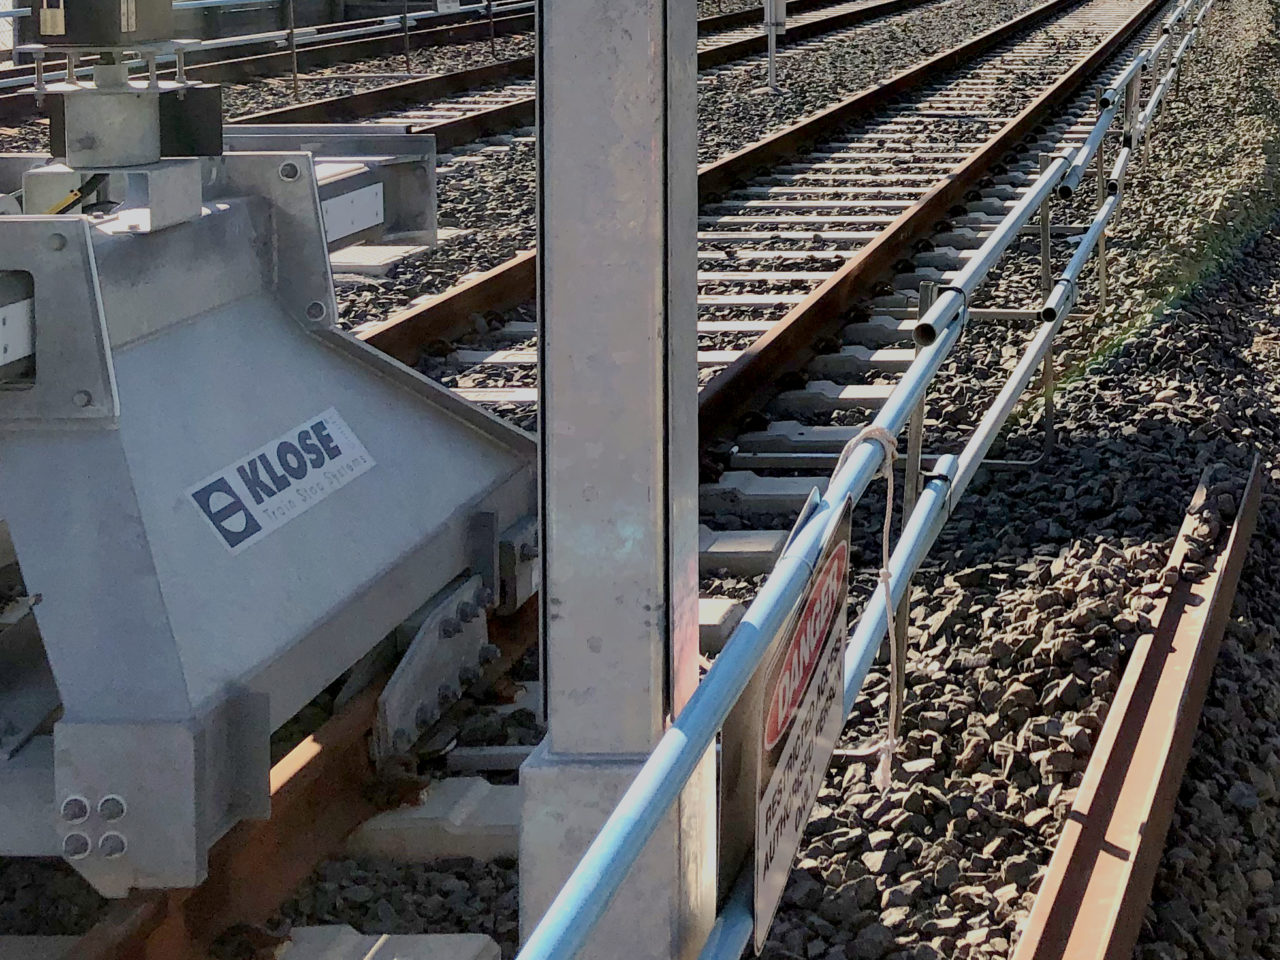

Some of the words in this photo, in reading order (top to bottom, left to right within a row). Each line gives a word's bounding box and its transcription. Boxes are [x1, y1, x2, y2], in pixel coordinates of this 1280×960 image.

[236, 420, 342, 505] KLOSE
[262, 499, 297, 521] Train
[323, 455, 368, 489] Systems
[777, 558, 840, 732] DANGER
[765, 700, 815, 836] RESTRICTED
